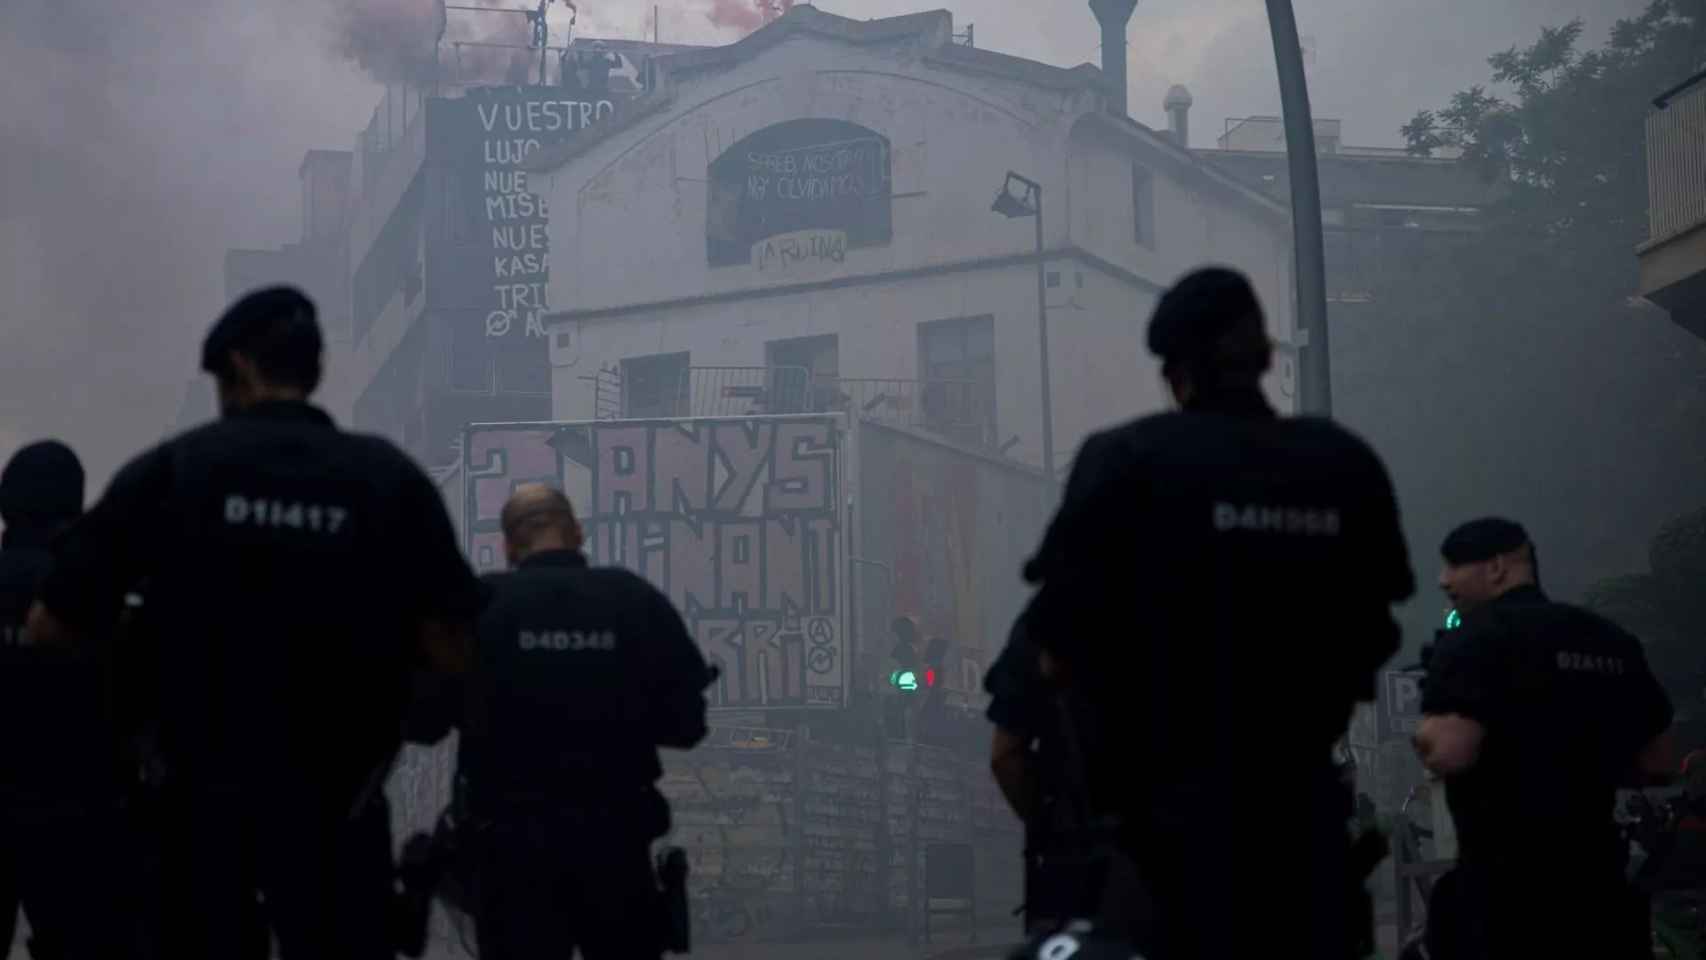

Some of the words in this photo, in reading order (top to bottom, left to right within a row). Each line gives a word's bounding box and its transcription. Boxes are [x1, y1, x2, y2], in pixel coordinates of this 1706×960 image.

[477, 99, 614, 132] VUESTRO
[484, 170, 526, 194] NUE
[485, 192, 550, 220] MISE
[592, 420, 840, 514] ANYS
[1395, 677, 1418, 713] P
